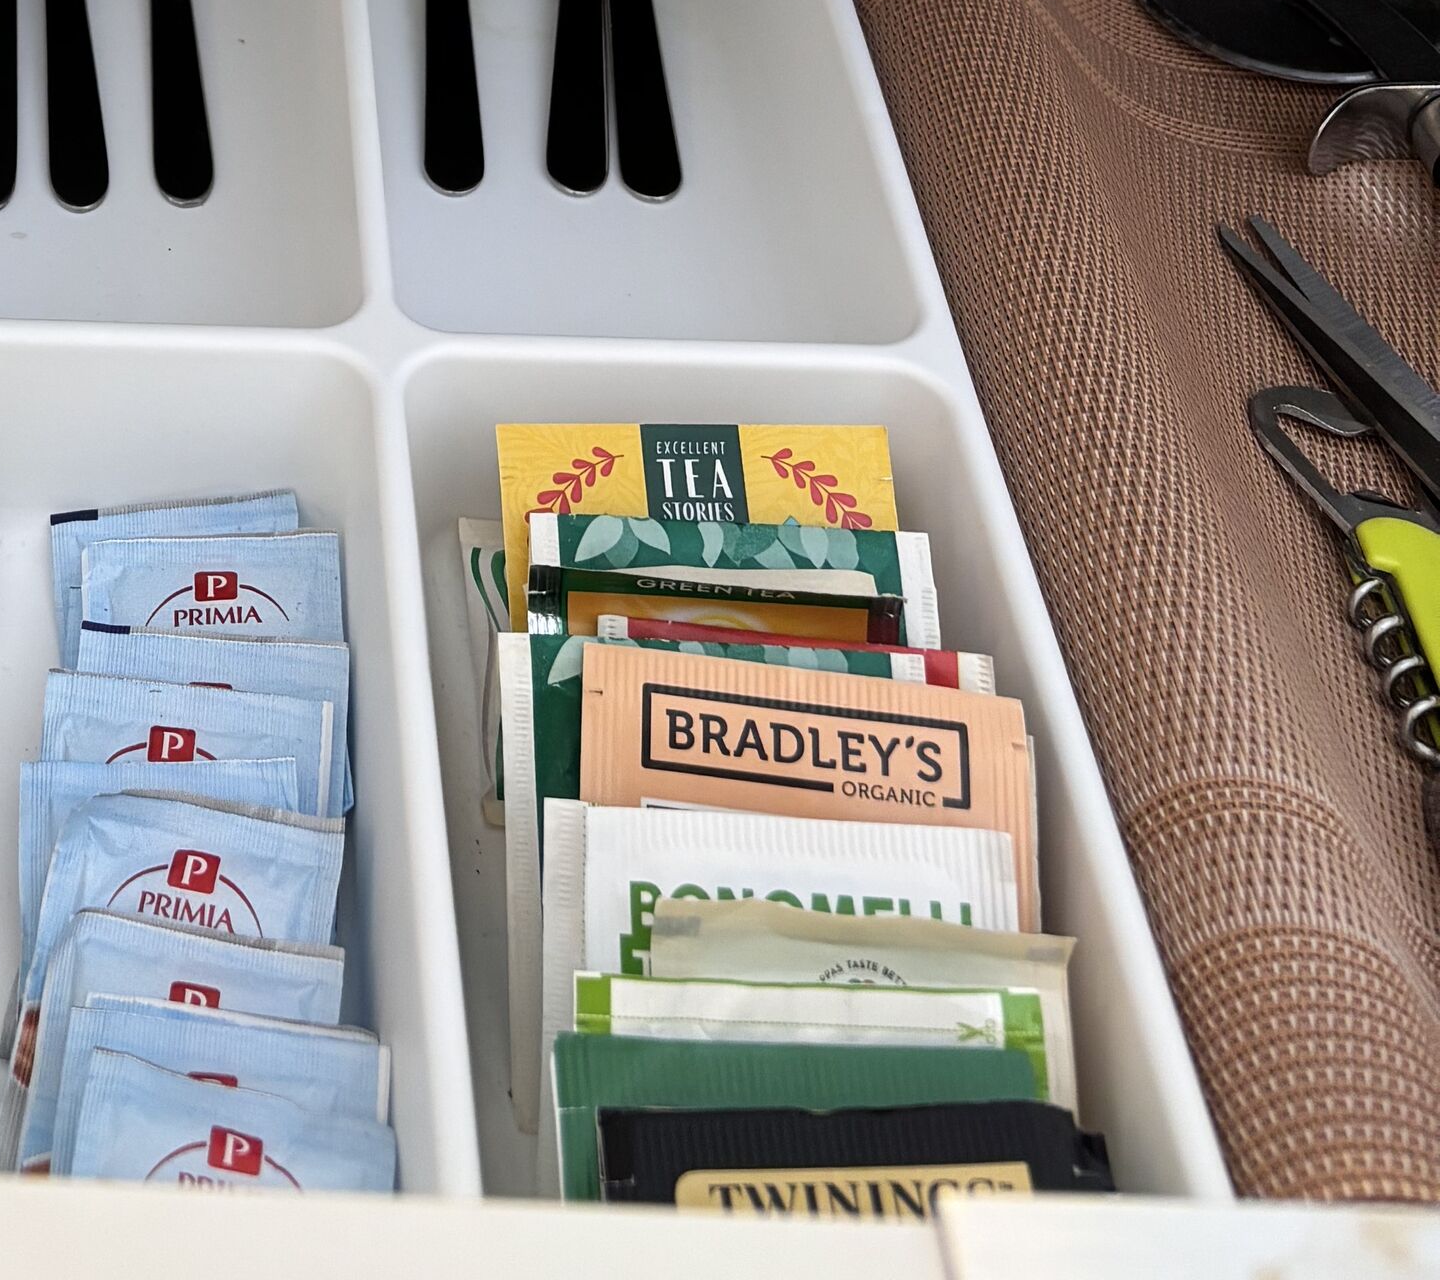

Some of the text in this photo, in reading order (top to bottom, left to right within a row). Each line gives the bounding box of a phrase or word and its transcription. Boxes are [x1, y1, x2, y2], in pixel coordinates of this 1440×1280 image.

[656, 440, 725, 455] EXCELLENT
[656, 458, 734, 499] TEA
[662, 500, 735, 522] STORIES
[206, 575, 228, 598] P
[636, 578, 796, 600] GREEN TEA
[173, 606, 262, 627] PRIMIA
[161, 731, 184, 759] P
[665, 708, 943, 783] BRADLEY'S
[841, 780, 936, 808] ORGANIC
[181, 855, 208, 885] P
[138, 890, 234, 934] PRIMIA
[847, 959, 879, 973] TASTE
[222, 1133, 250, 1167] P
